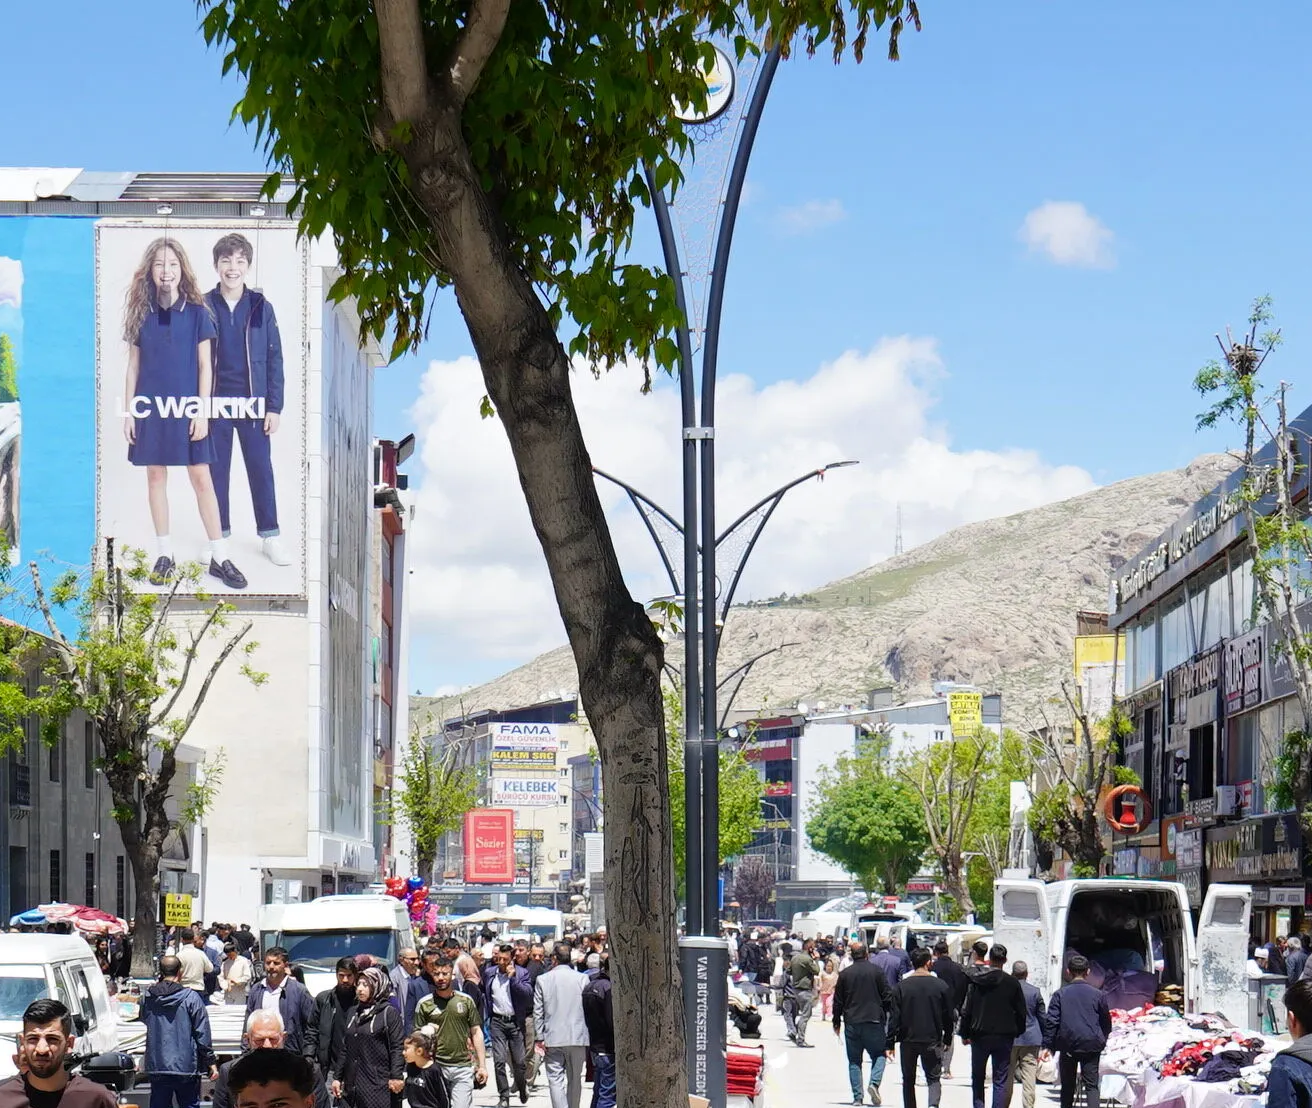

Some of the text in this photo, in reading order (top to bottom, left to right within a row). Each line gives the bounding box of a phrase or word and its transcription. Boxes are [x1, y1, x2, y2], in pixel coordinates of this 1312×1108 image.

[116, 396, 152, 419] LC
[500, 725, 551, 735] FAMA
[492, 751, 529, 759] KALEM
[503, 780, 557, 793] KELEBEK
[696, 956, 708, 981] VAN
